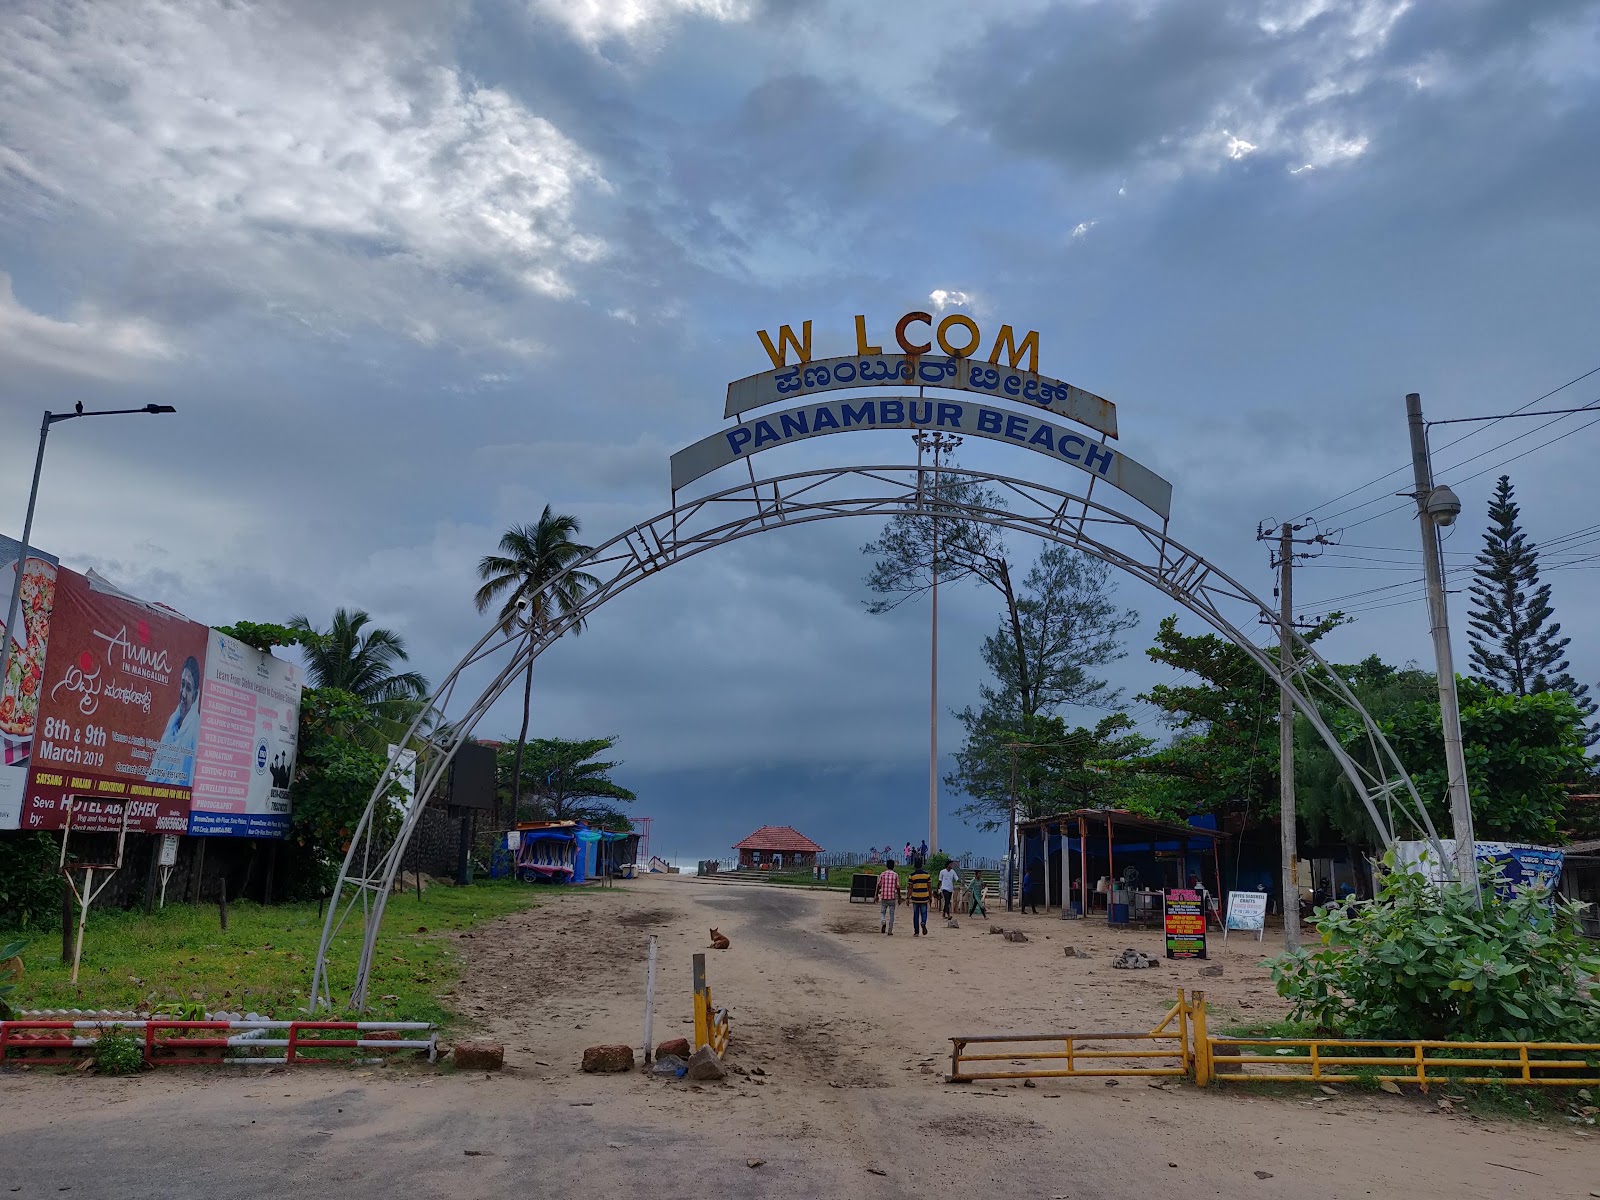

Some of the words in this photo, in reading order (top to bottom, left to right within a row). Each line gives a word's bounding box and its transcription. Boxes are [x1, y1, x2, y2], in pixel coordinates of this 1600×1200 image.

[775, 357, 958, 394] ಪಣಂಬೂರ್
[969, 366, 1069, 405] ಬೀಚ್
[726, 401, 963, 456] PANAMBUR
[977, 409, 1114, 475] BEACH
[93, 625, 172, 673] Amma
[122, 661, 130, 671] IN
[131, 665, 169, 684] MANGALURU
[216, 669, 229, 682] Learn
[230, 673, 241, 685] From
[241, 677, 253, 690] Global
[254, 682, 266, 694] Leader
[208, 700, 230, 713] FASHION
[231, 706, 248, 717] DESIGN
[44, 717, 70, 740] 8th
[74, 728, 81, 742] &
[85, 724, 107, 747] 9th
[218, 736, 250, 749] DEVELOPMENT
[40, 740, 81, 763] March
[83, 751, 104, 767] 2019
[204, 750, 233, 762] ANIMATION
[201, 766, 223, 776] EDITING
[227, 770, 238, 778] VFX
[36, 773, 62, 787] SATSANG
[71, 777, 92, 789] BHAJAN
[98, 780, 125, 794] MEDITATION
[198, 783, 227, 794] JEWELLERY
[227, 787, 245, 796] DESIGN
[33, 796, 55, 809] Seva
[104, 801, 159, 817] ABISHEK
[196, 799, 233, 810] PHOTOGRAPHY
[29, 812, 44, 827] by:
[77, 814, 87, 822] Veg
